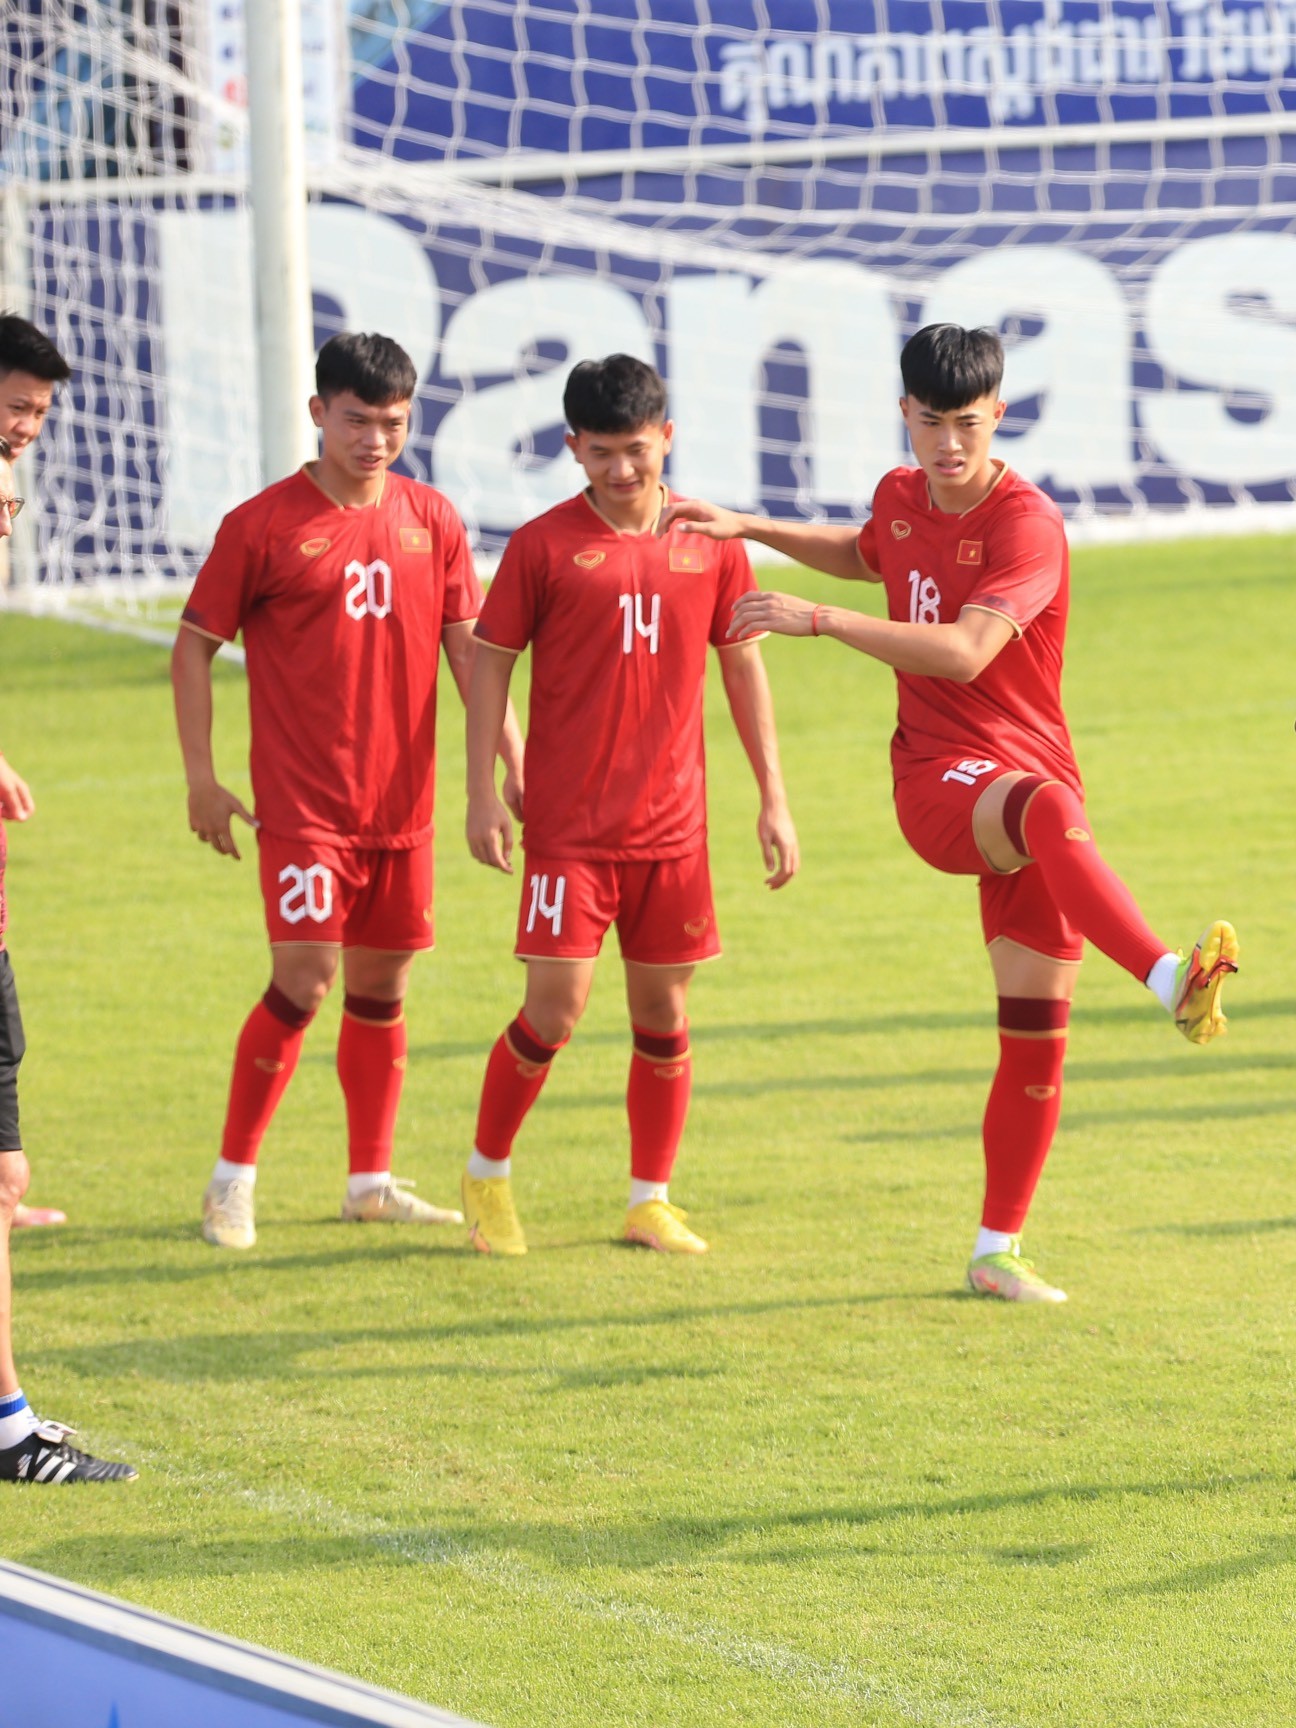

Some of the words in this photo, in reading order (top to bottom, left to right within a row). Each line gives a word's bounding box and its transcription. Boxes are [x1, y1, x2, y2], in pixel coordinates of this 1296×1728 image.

[344, 558, 394, 622] 20
[908, 568, 942, 623] 18
[618, 592, 661, 655] 14
[940, 758, 999, 787] 18
[278, 862, 335, 924] 20
[526, 874, 566, 936] 14
